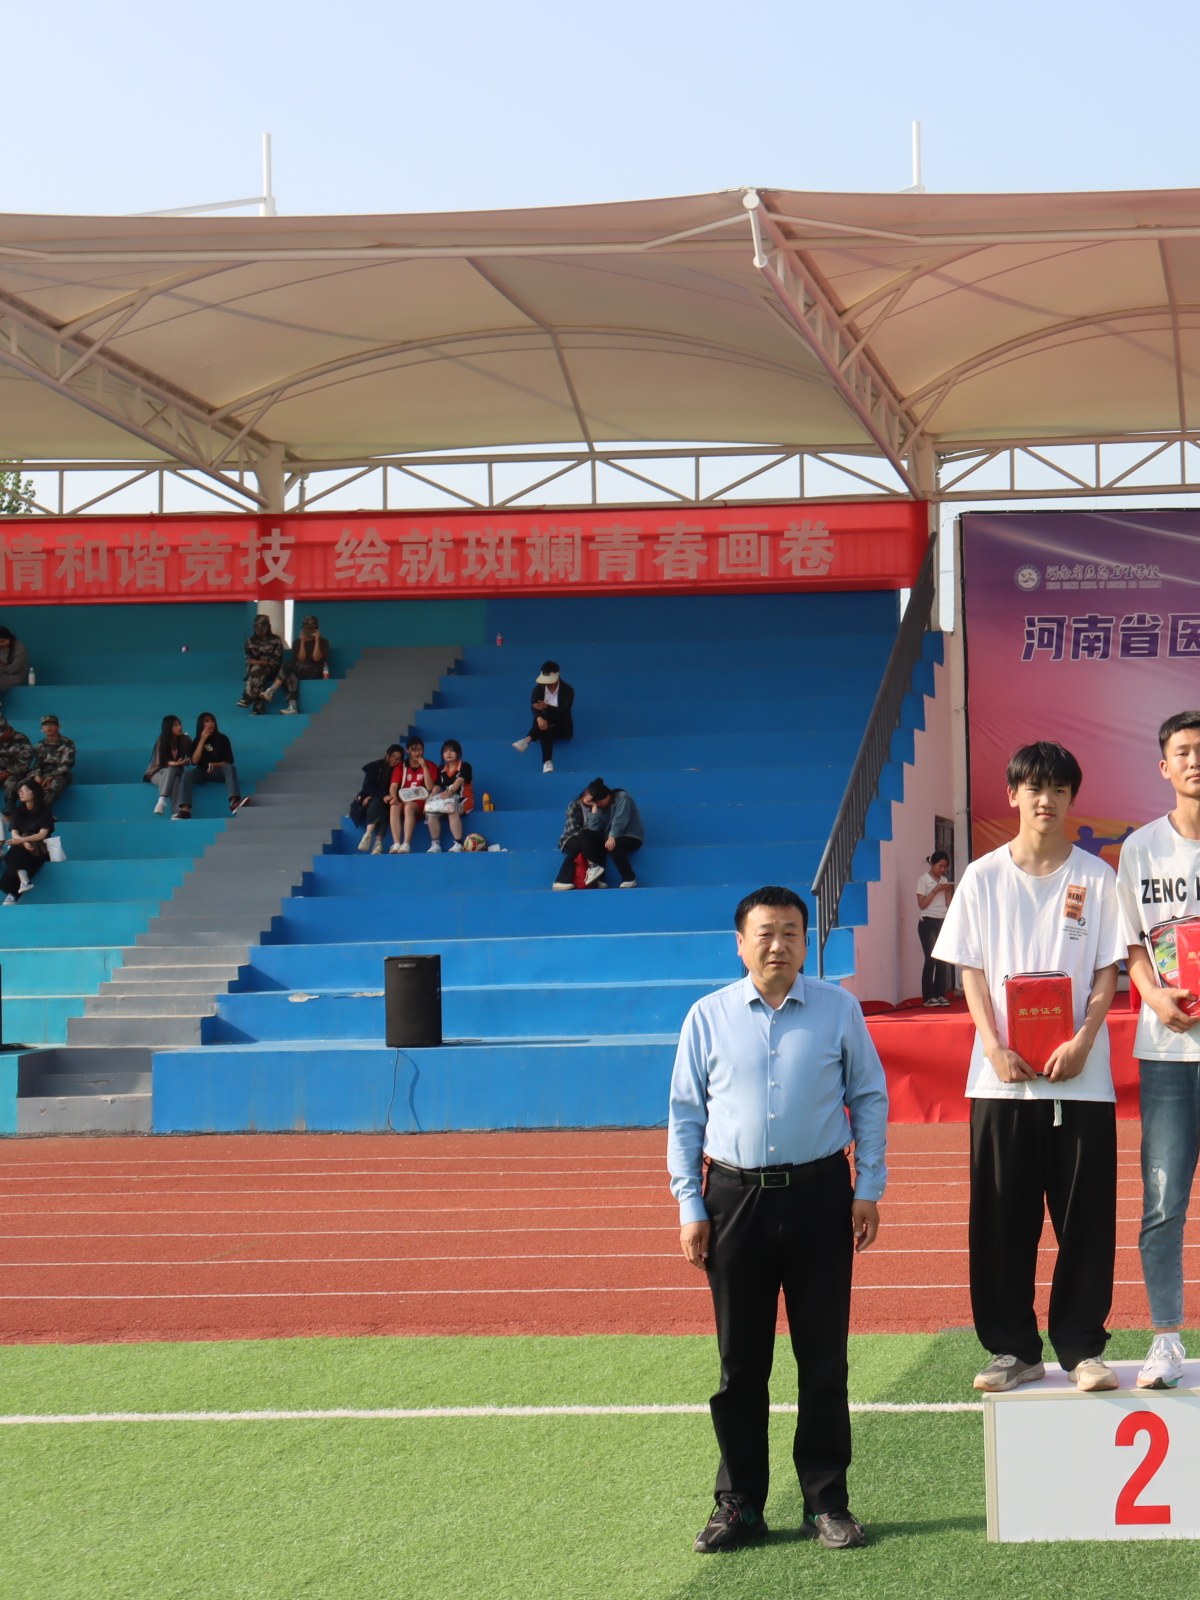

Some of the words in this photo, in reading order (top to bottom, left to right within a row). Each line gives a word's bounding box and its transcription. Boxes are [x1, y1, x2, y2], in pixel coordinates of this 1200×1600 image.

[0, 527, 297, 592] 情和谐竞技
[333, 519, 837, 585] 绘就斑斓青春画卷
[1141, 878, 1187, 904] ZENC
[1018, 1006, 1062, 1016] 荣誉证书
[1115, 1410, 1170, 1524] 2
